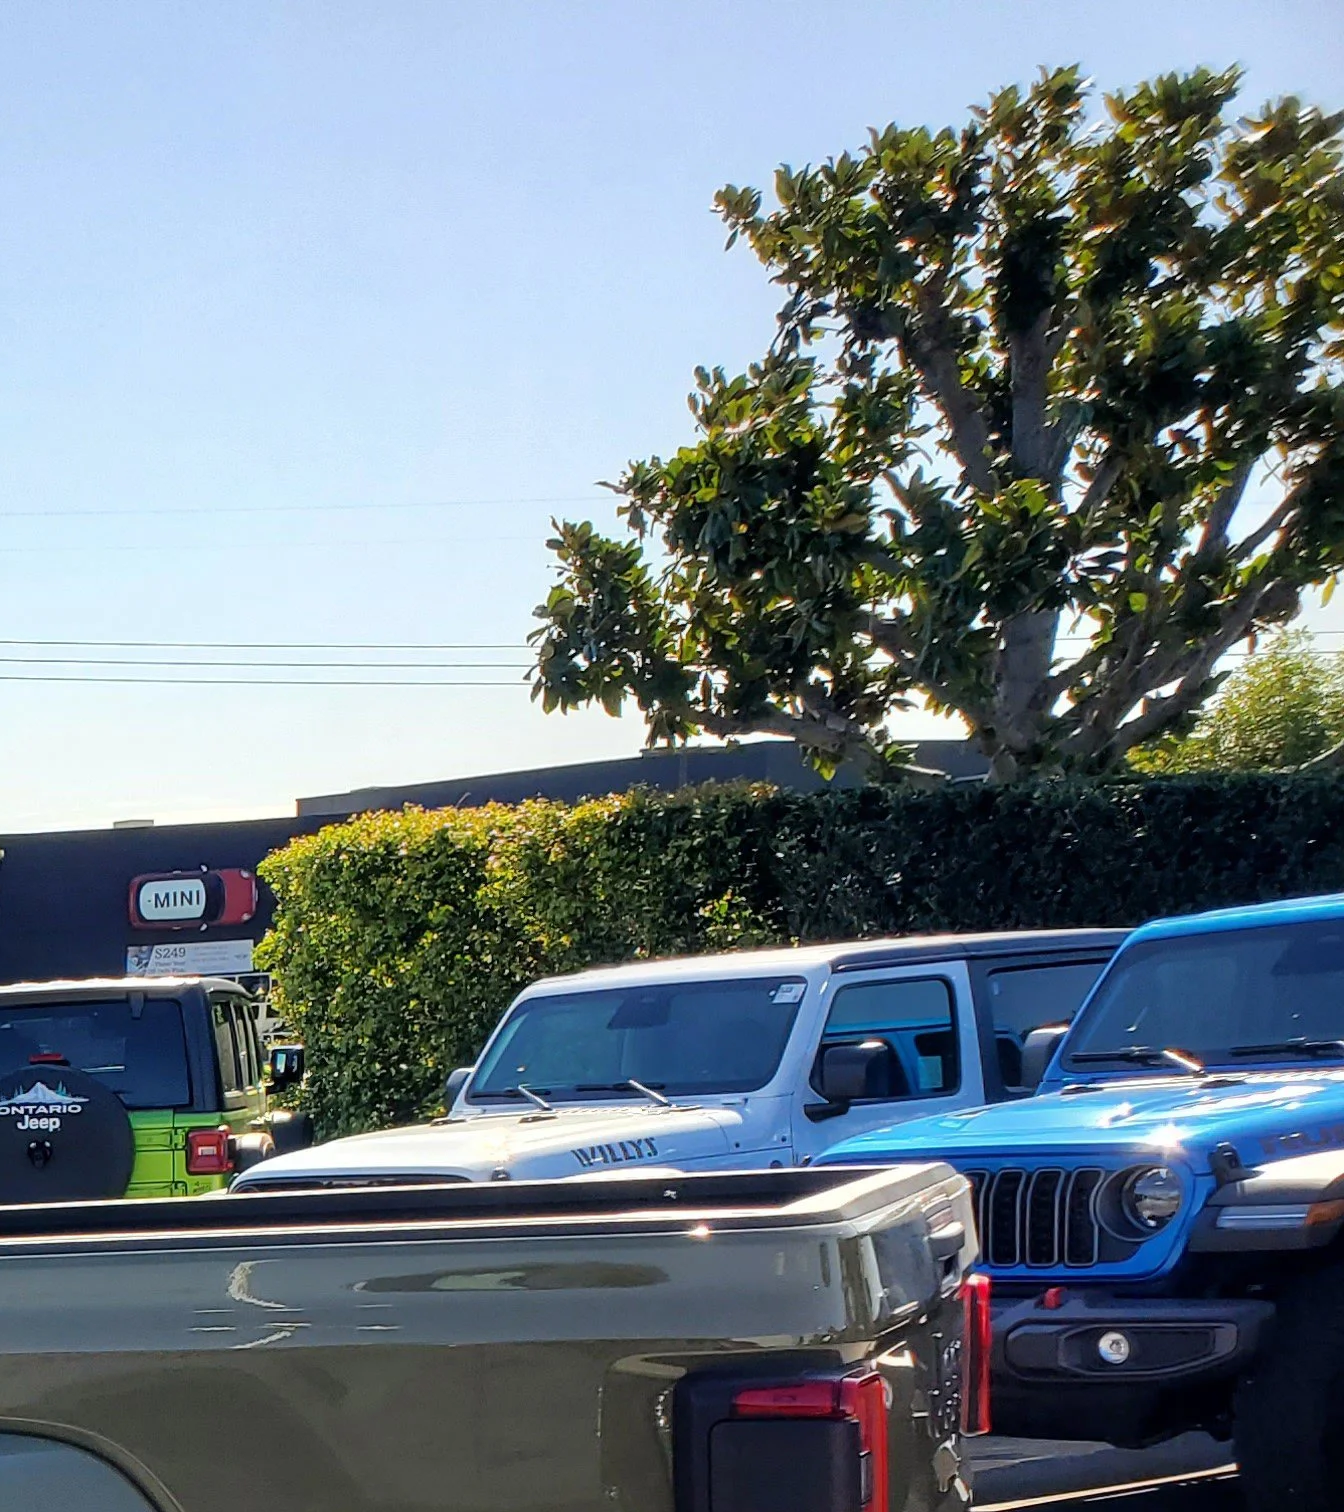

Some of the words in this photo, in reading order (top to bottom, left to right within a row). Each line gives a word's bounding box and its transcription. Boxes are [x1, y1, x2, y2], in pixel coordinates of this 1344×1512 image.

[153, 889, 200, 908] MINI
[16, 1115, 61, 1132] Jeep
[570, 1136, 659, 1167] WILLYS
